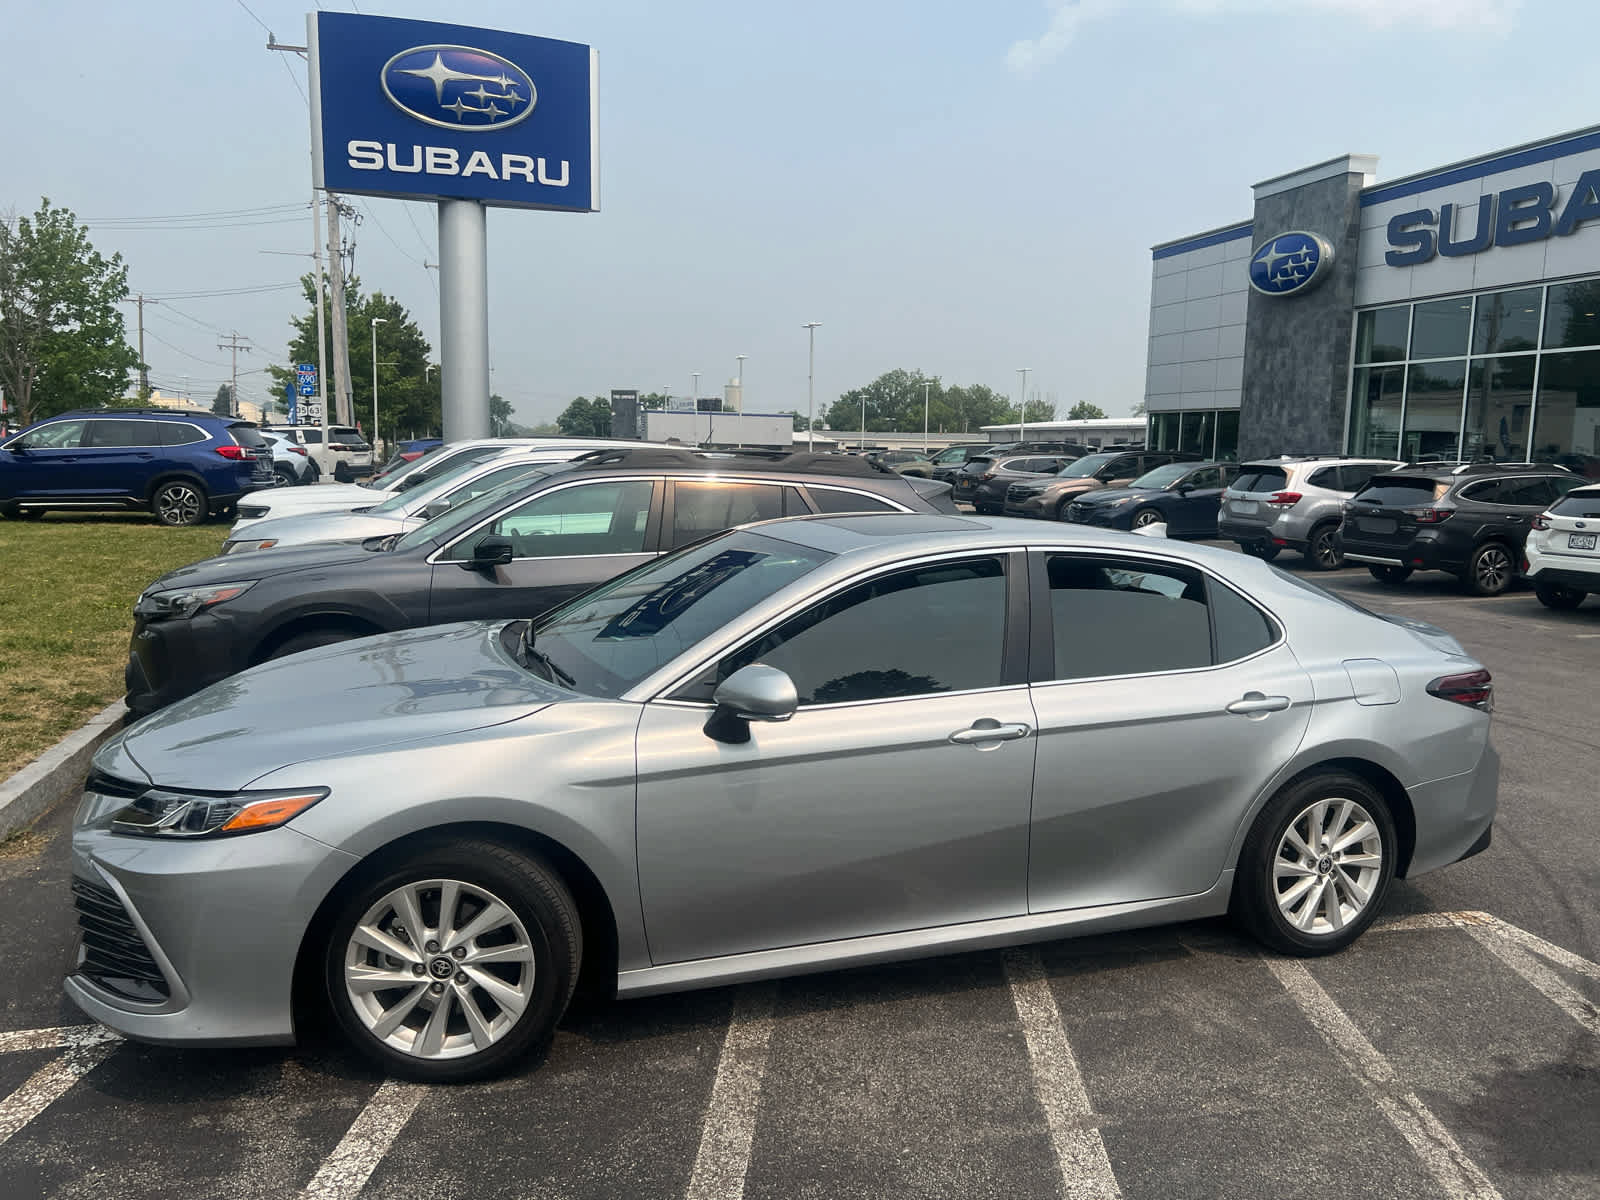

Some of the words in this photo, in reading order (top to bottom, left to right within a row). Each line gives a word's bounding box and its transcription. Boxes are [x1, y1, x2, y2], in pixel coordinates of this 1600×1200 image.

[348, 140, 570, 187] SUBARU
[1385, 169, 1600, 267] SUBA
[301, 375, 315, 384] 690
[310, 407, 321, 415] 63
